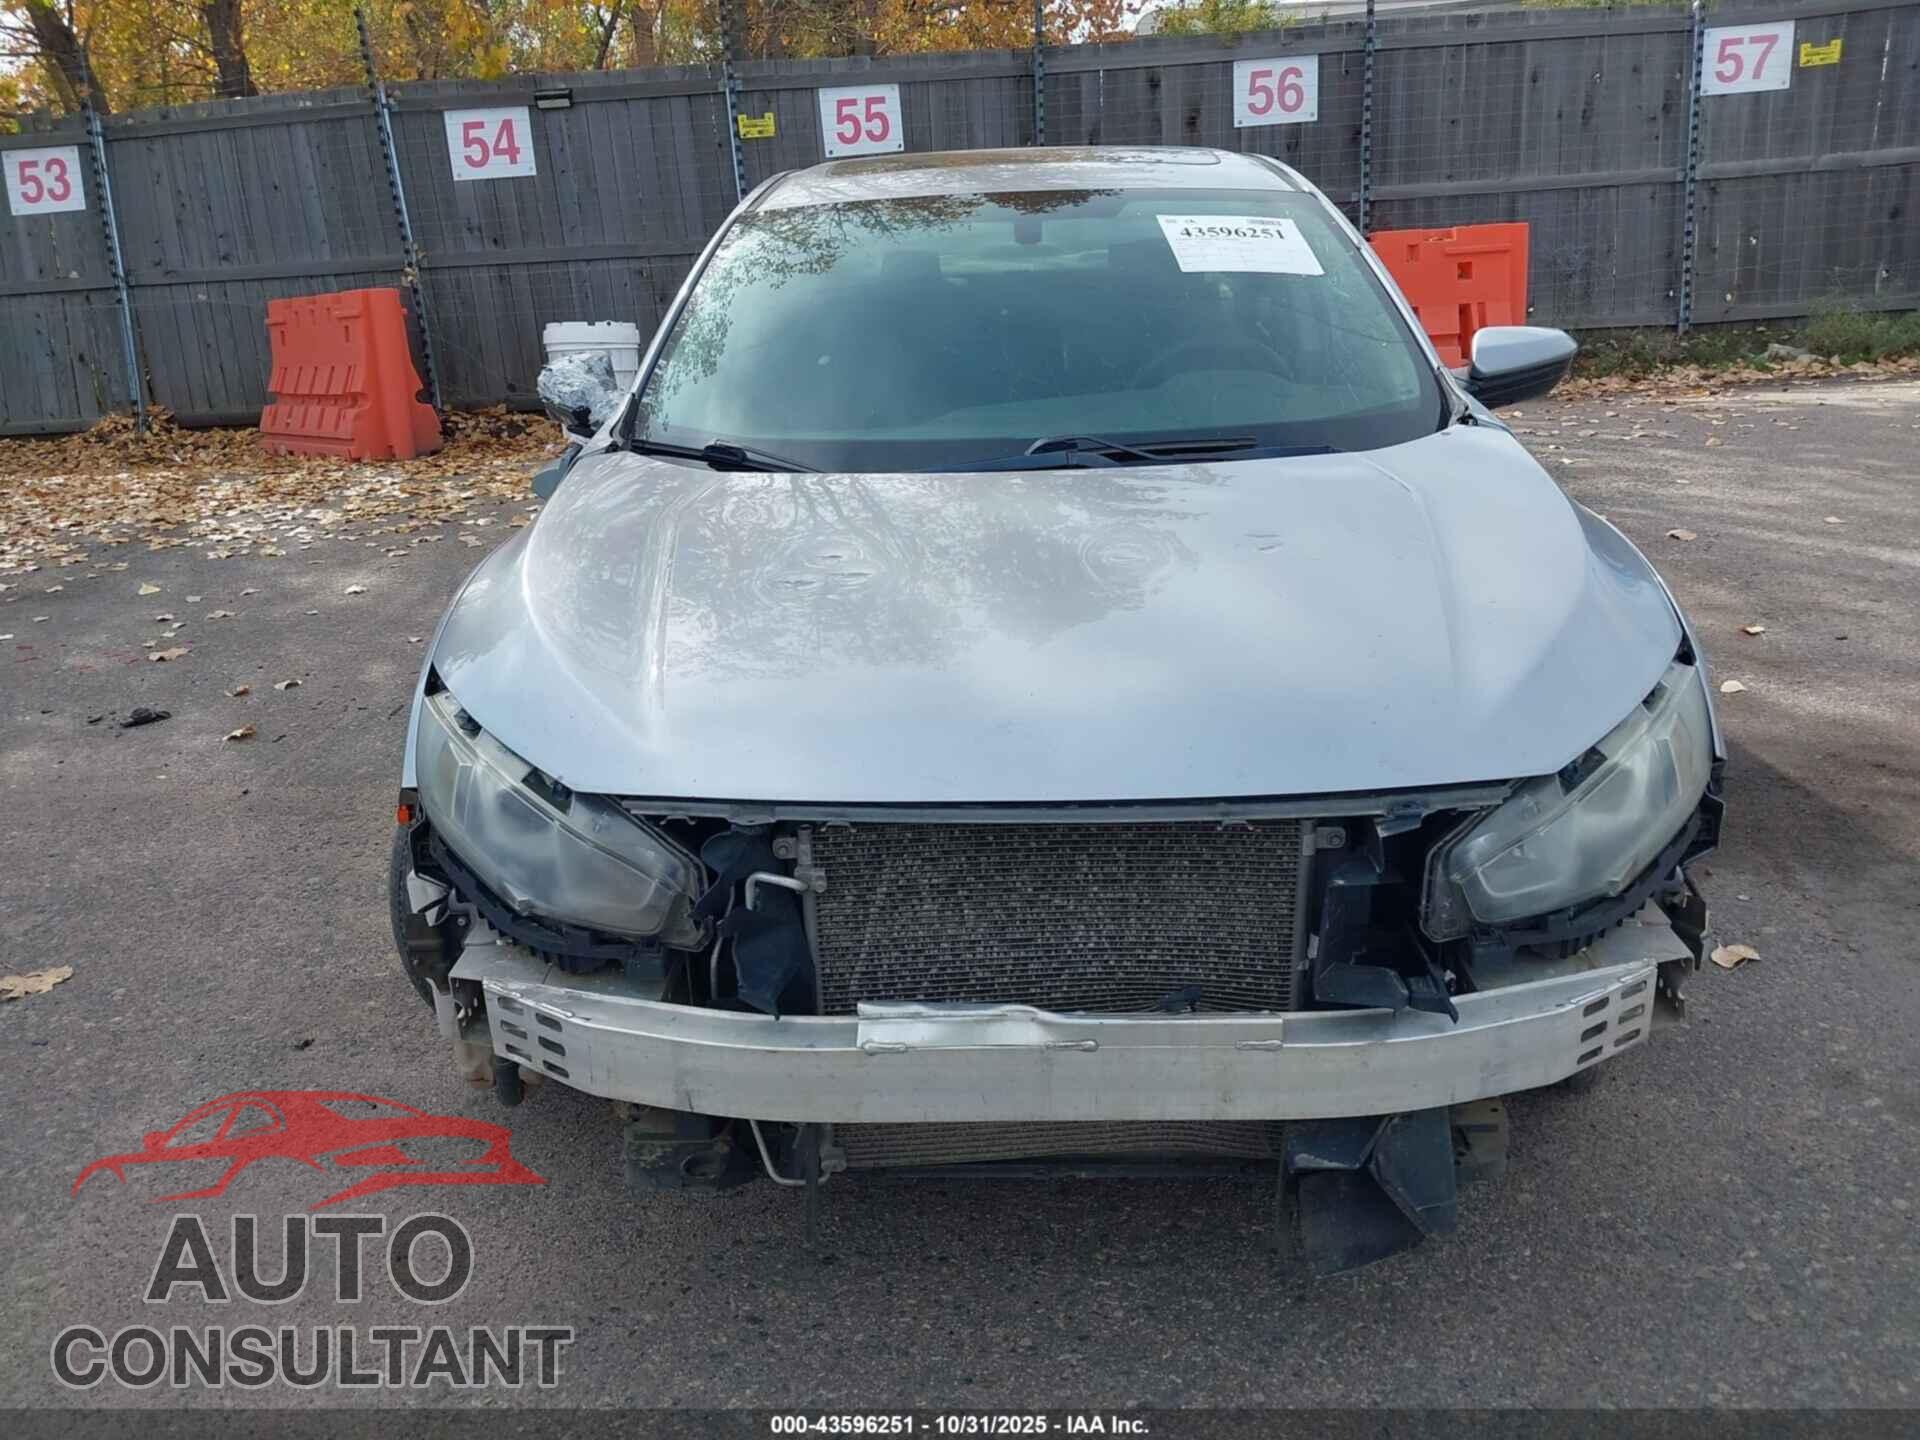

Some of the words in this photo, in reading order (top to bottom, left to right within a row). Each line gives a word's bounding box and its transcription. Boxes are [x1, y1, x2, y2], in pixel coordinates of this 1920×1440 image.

[1714, 33, 1779, 85] 57
[1247, 67, 1305, 116] 56
[462, 118, 521, 168] 54
[836, 96, 891, 145] 55
[18, 157, 72, 204] 53
[1179, 226, 1286, 240] 43596251
